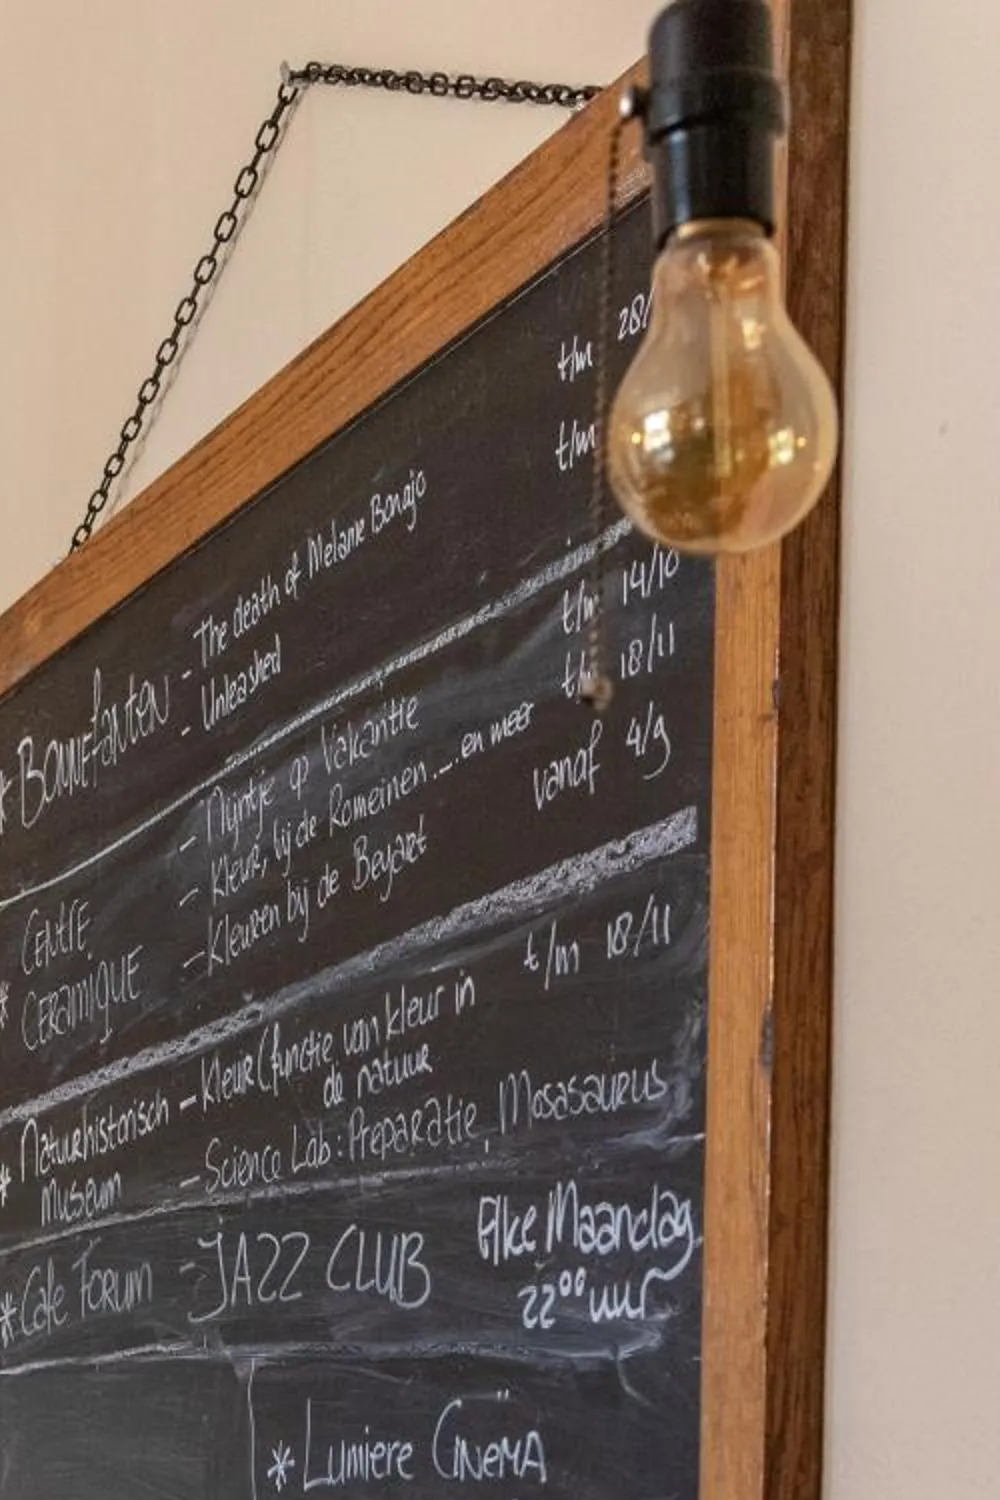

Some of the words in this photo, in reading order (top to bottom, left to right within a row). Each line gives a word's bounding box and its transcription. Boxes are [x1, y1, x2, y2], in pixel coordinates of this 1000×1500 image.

[622, 540, 681, 608] 14/10
[193, 614, 229, 669] The
[232, 573, 281, 639] death
[285, 550, 303, 601] of
[620, 612, 676, 681] 18/11
[625, 700, 672, 781] 4/9
[294, 807, 318, 849] de
[316, 862, 341, 909] de
[523, 918, 580, 992] t/m
[606, 893, 672, 960] 18/11
[455, 968, 476, 1016] in
[323, 1062, 345, 1109] de
[205, 1137, 283, 1195] Science
[187, 1230, 311, 1323] JAZZ
[325, 1222, 432, 1310] CLUB
[588, 1266, 662, 1324] uur
